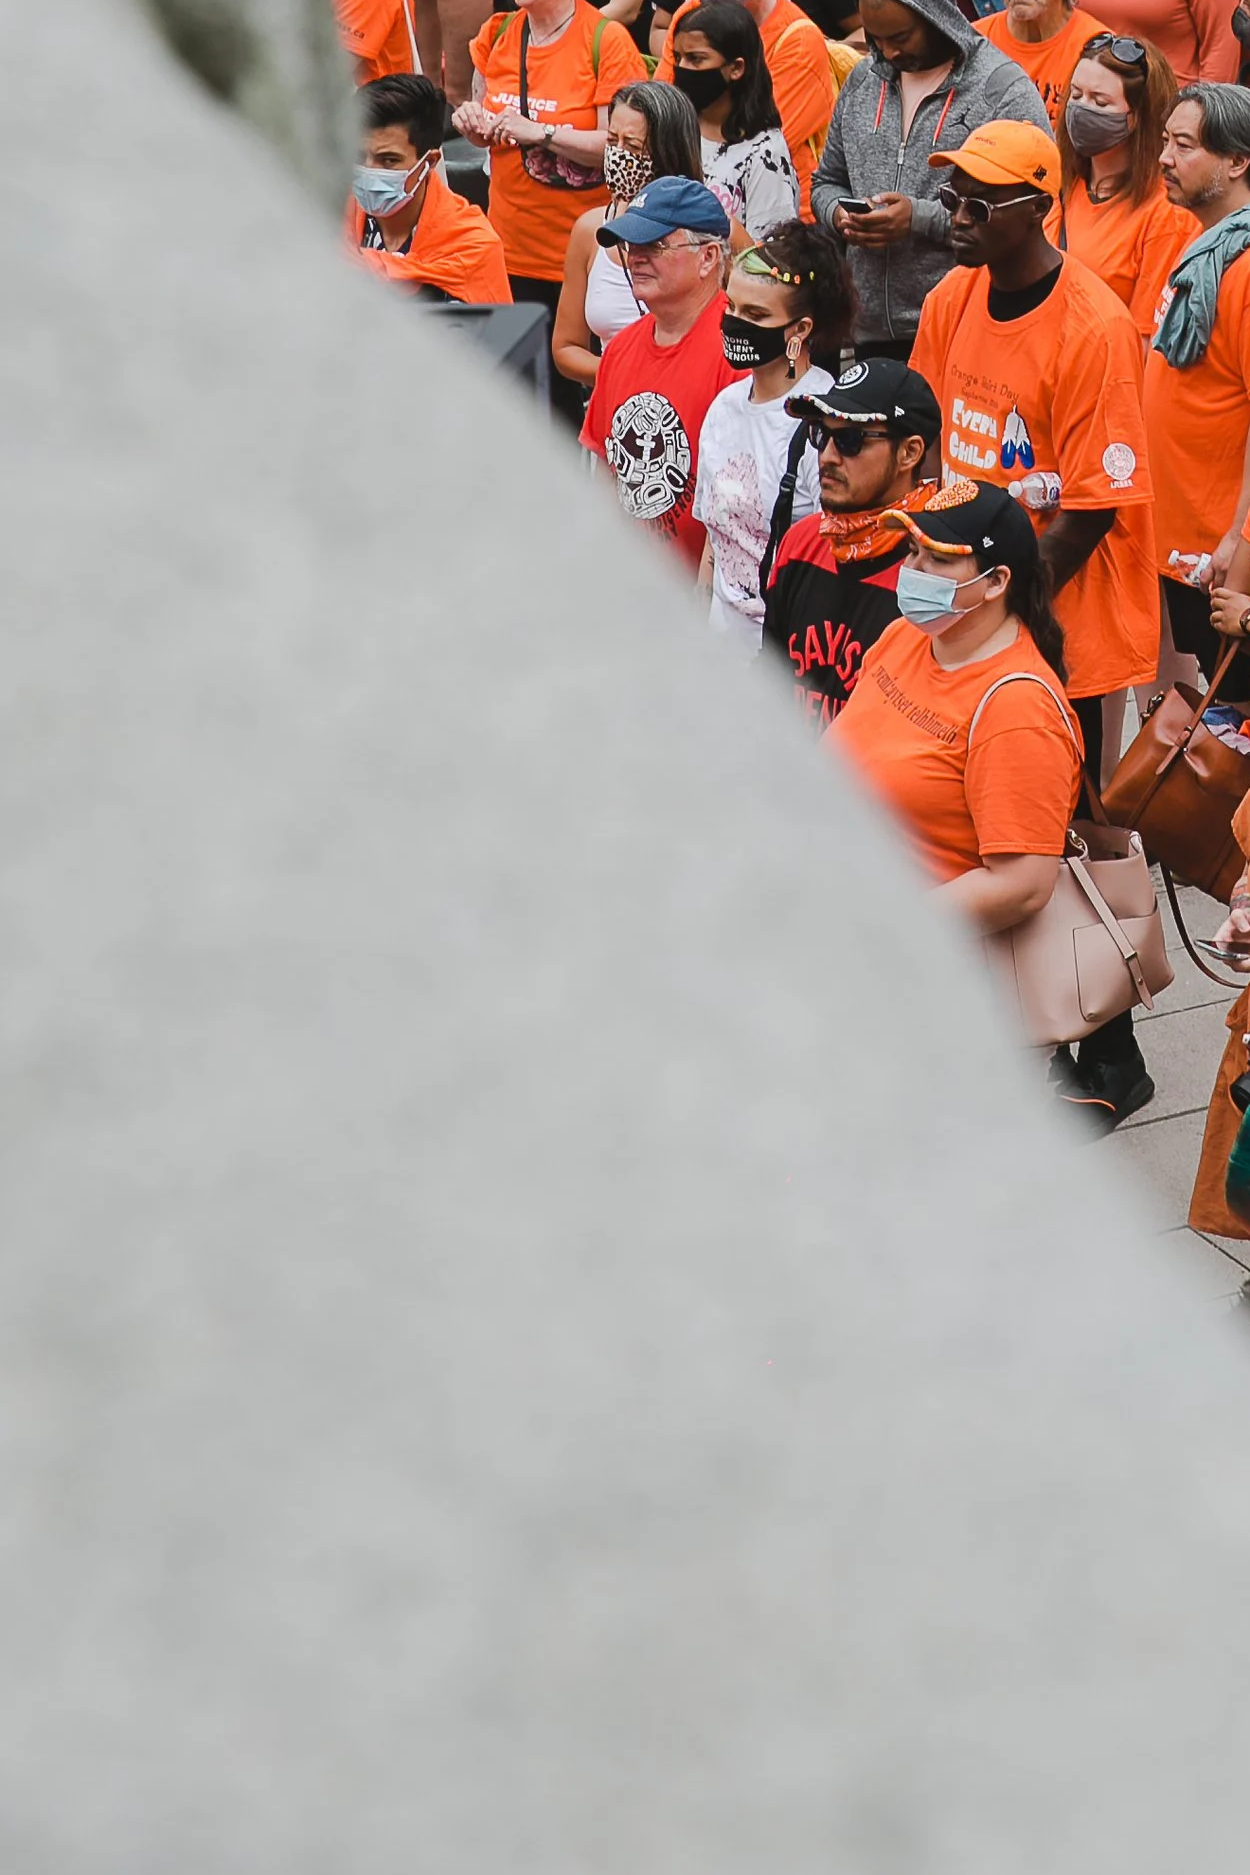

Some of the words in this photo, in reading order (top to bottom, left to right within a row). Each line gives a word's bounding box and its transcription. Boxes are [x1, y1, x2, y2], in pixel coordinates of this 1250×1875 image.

[724, 350, 761, 363] GENOUS
[725, 343, 755, 355] LIENT
[951, 397, 998, 439] EVERY
[948, 430, 997, 470] CHILD
